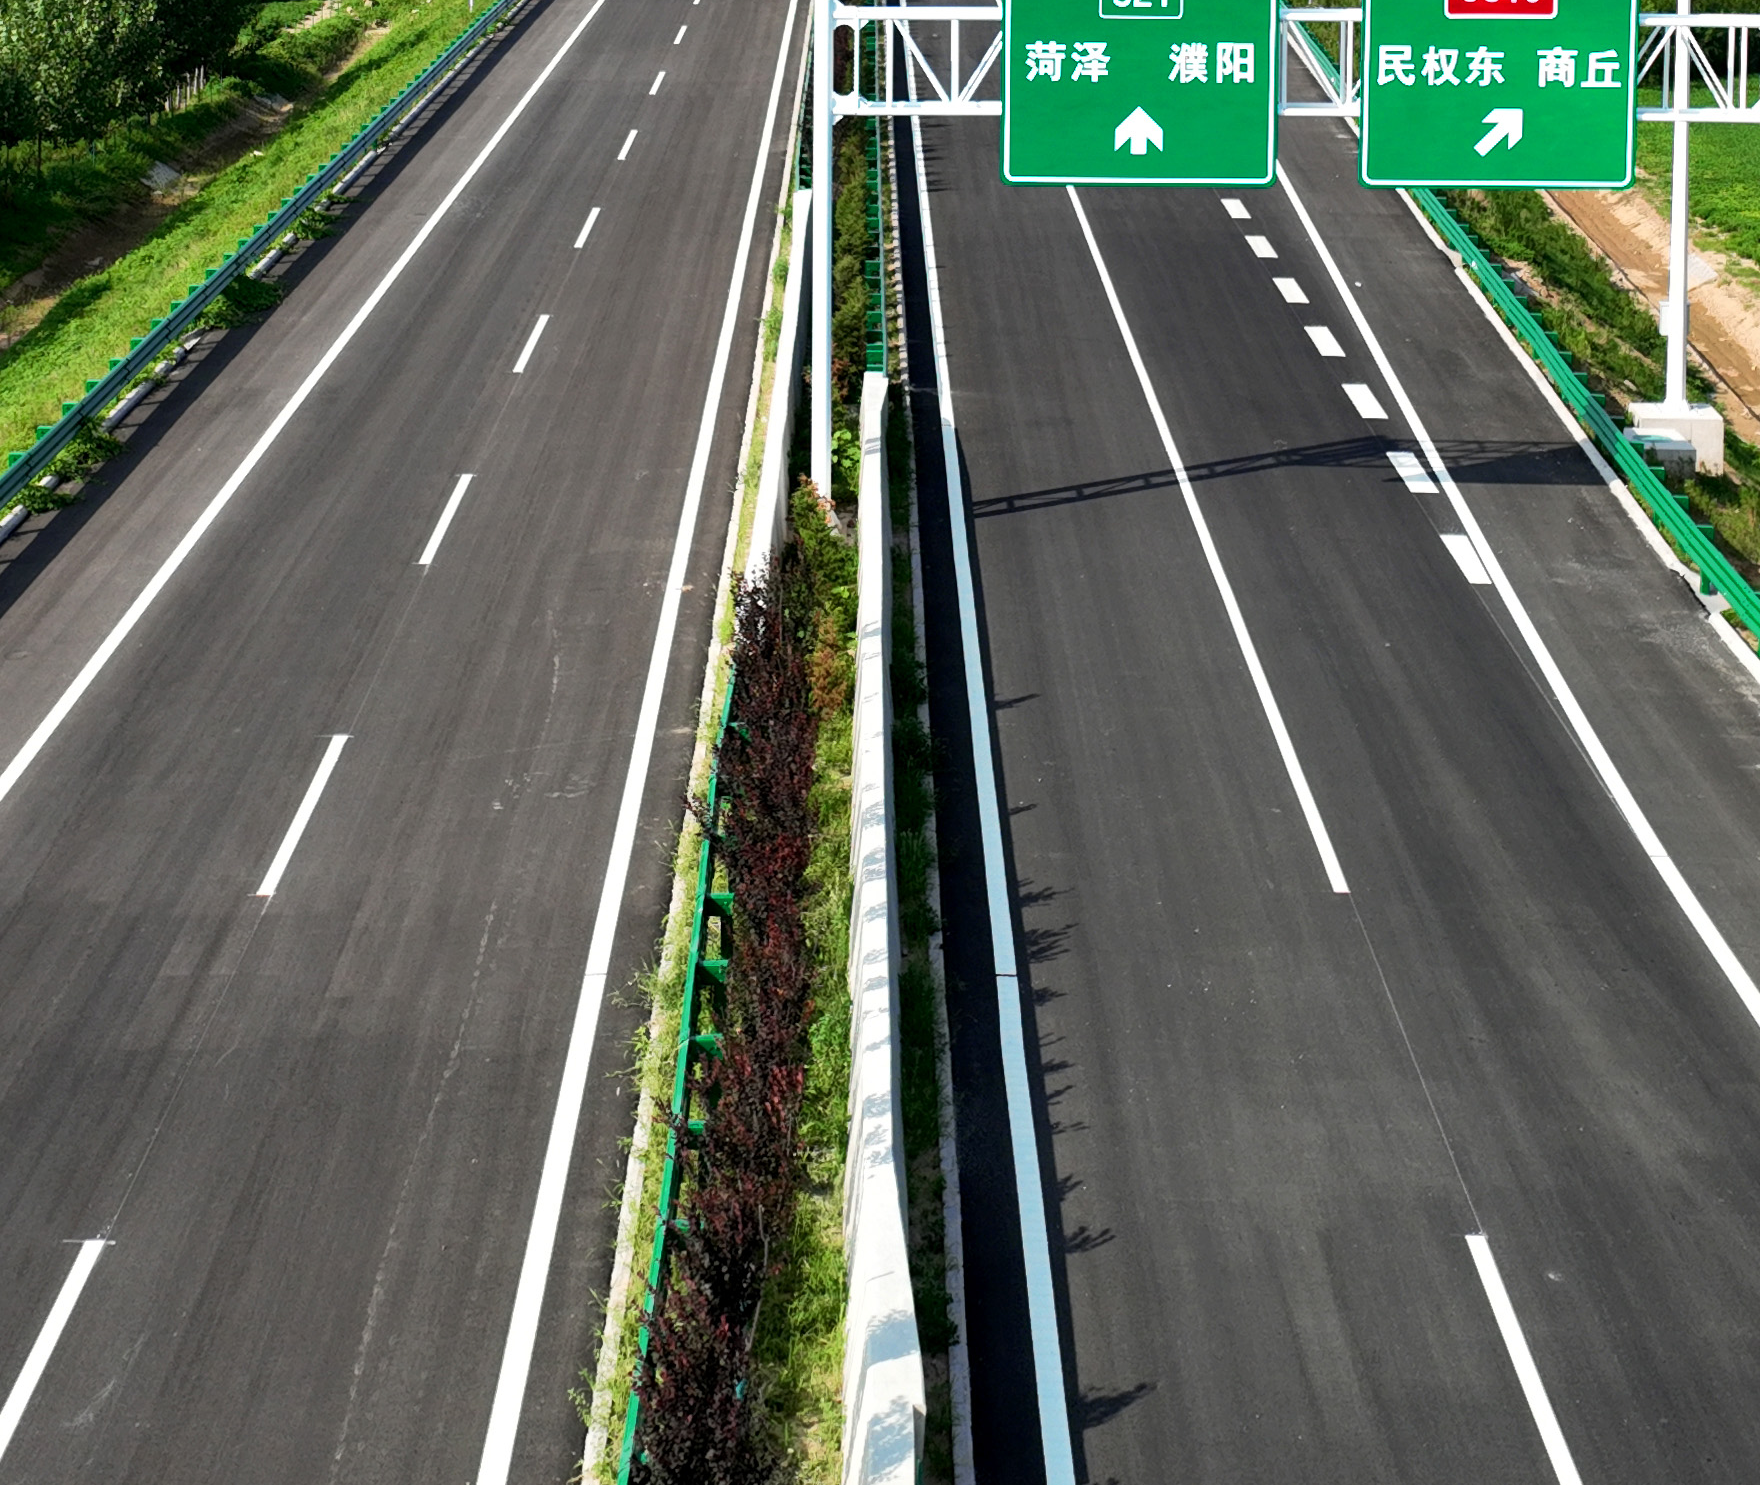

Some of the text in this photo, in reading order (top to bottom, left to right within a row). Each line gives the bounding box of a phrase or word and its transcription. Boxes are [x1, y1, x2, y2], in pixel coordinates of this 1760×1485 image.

[1025, 40, 1256, 84] 菏泽 濮阳
[1376, 44, 1622, 89] 民权东 商丘
